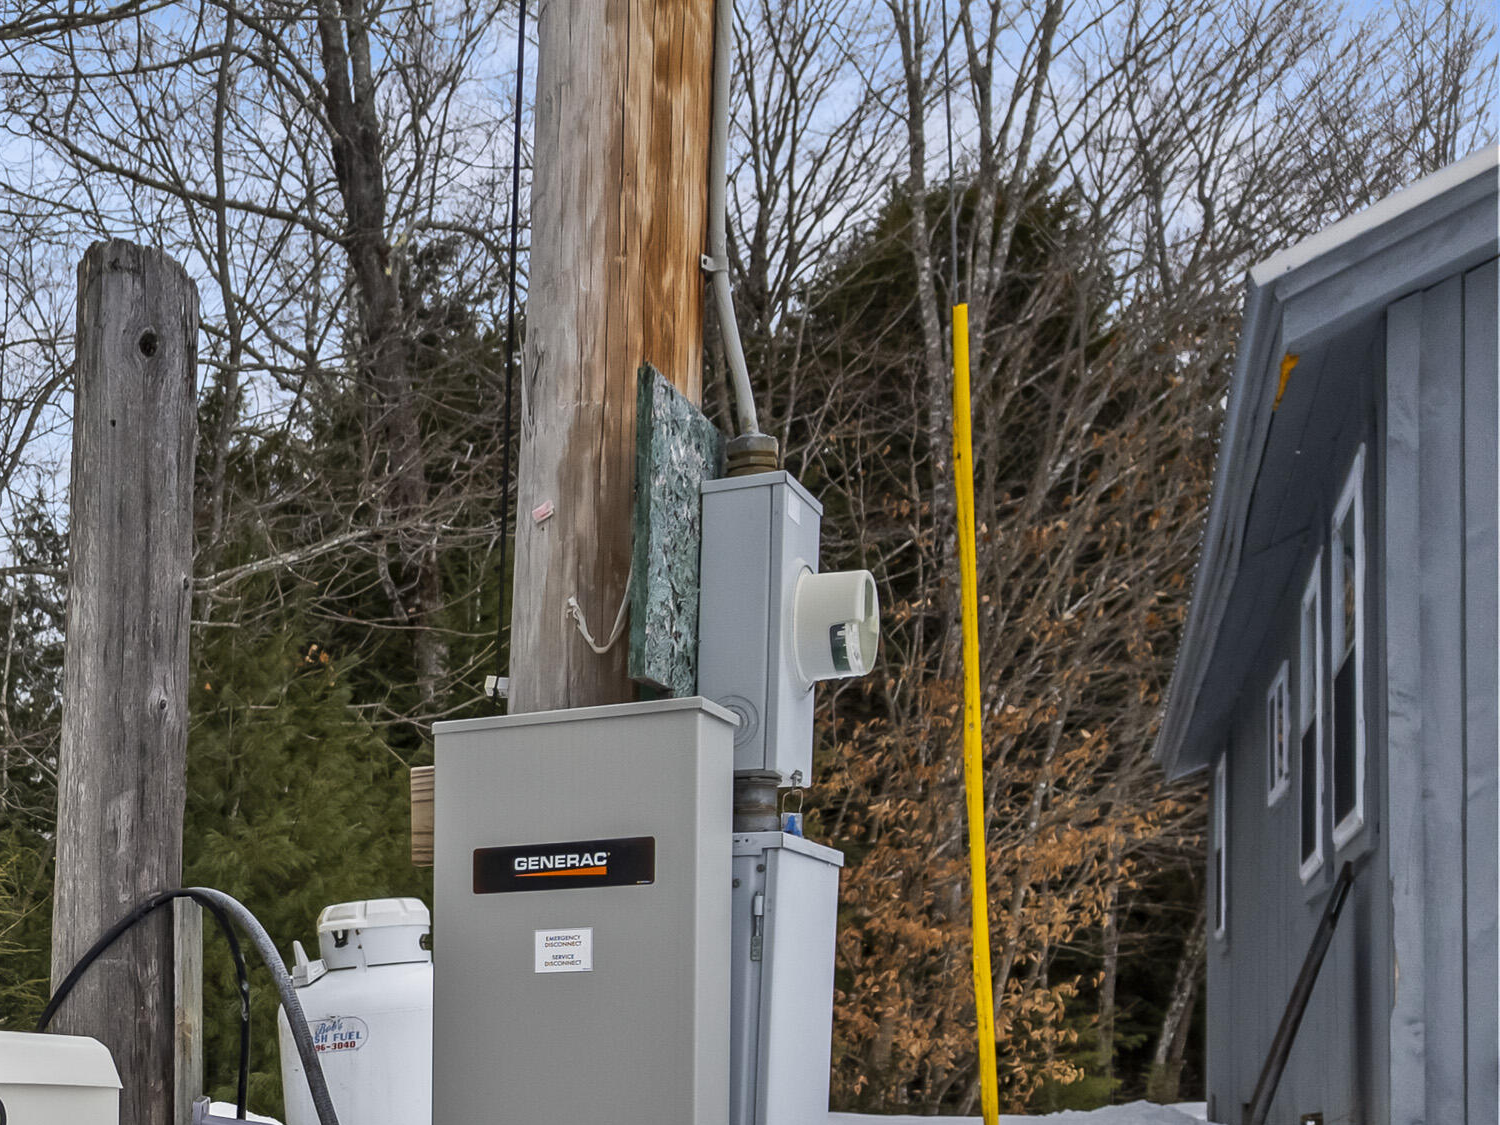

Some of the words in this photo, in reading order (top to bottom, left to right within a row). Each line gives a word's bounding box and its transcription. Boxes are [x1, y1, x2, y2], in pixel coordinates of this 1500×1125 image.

[514, 852, 607, 871] GENERAC
[333, 1031, 362, 1042] FUEL
[315, 1041, 356, 1051] 96-3040
